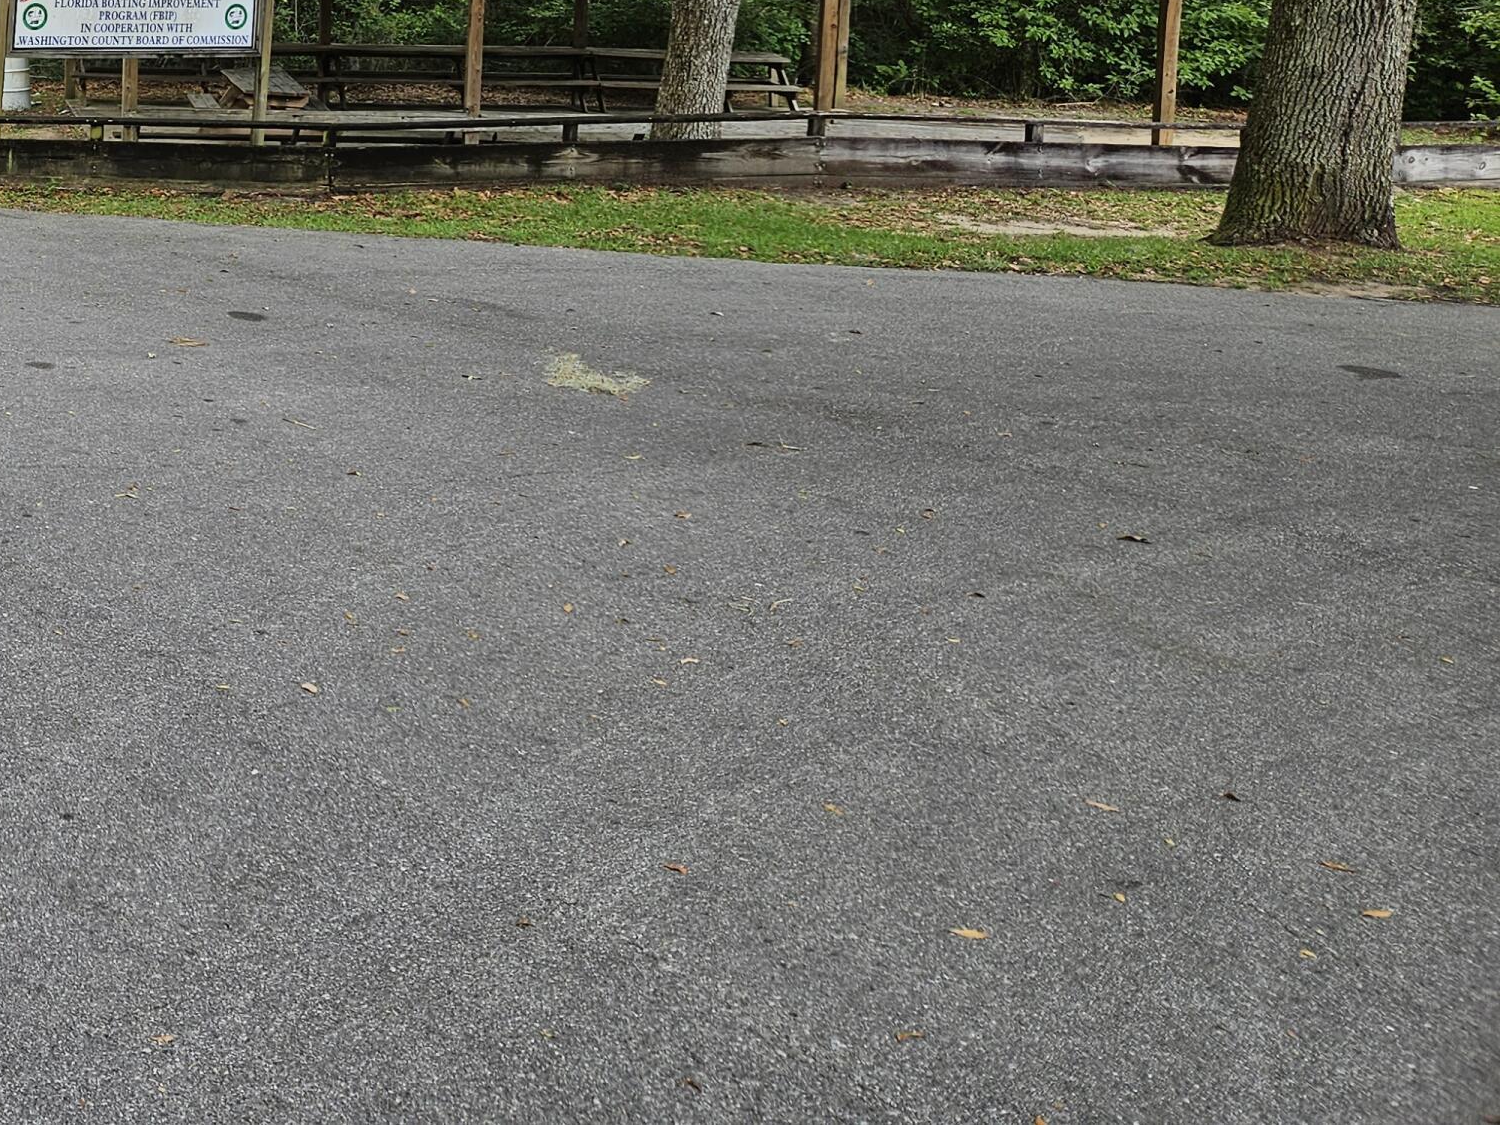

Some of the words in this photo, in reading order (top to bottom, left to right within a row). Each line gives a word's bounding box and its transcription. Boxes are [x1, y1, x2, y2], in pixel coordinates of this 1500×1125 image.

[148, 0, 221, 9] IMPROVEMENT
[99, 11, 147, 21] PROGRAM
[150, 11, 177, 22] (FBIP)
[81, 23, 91, 33] IN
[94, 23, 164, 33] COOPERATION
[167, 23, 193, 33] WITH
[91, 36, 133, 46] COUNTY
[136, 36, 169, 45] BOARD
[172, 36, 185, 45] OF
[187, 35, 249, 45] COMMISSION
